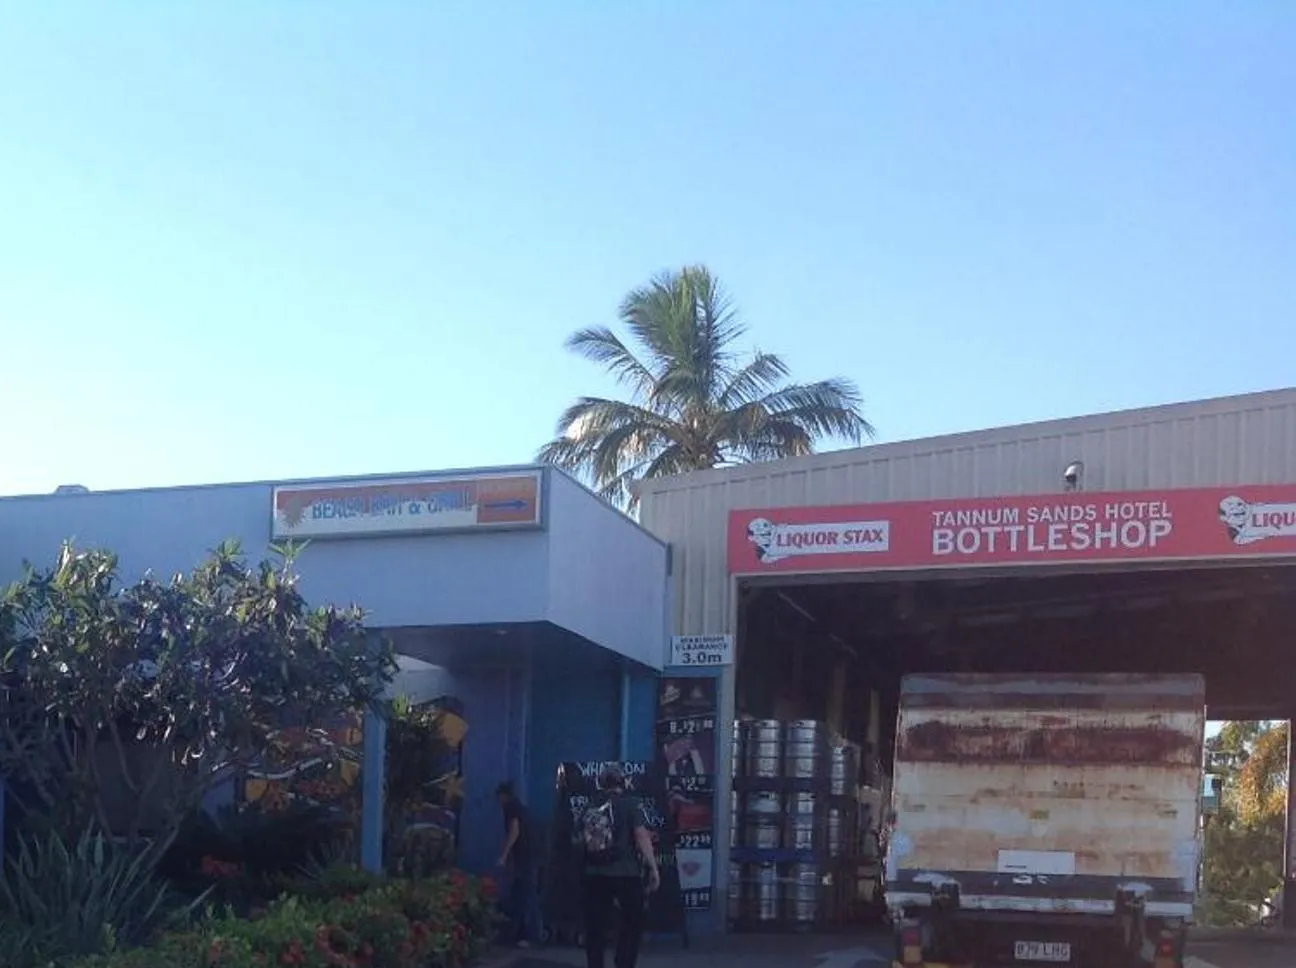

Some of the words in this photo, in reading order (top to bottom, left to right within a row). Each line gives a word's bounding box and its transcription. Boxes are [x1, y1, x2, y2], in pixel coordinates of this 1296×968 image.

[932, 507, 1019, 527] TANNUM
[1026, 504, 1097, 523] SANDS
[1104, 501, 1172, 521] HOTEL
[776, 530, 838, 549] LIQUOR
[843, 528, 883, 545] STAX
[932, 520, 1172, 555] BOTTLESHOP
[682, 651, 722, 664] 3.0m
